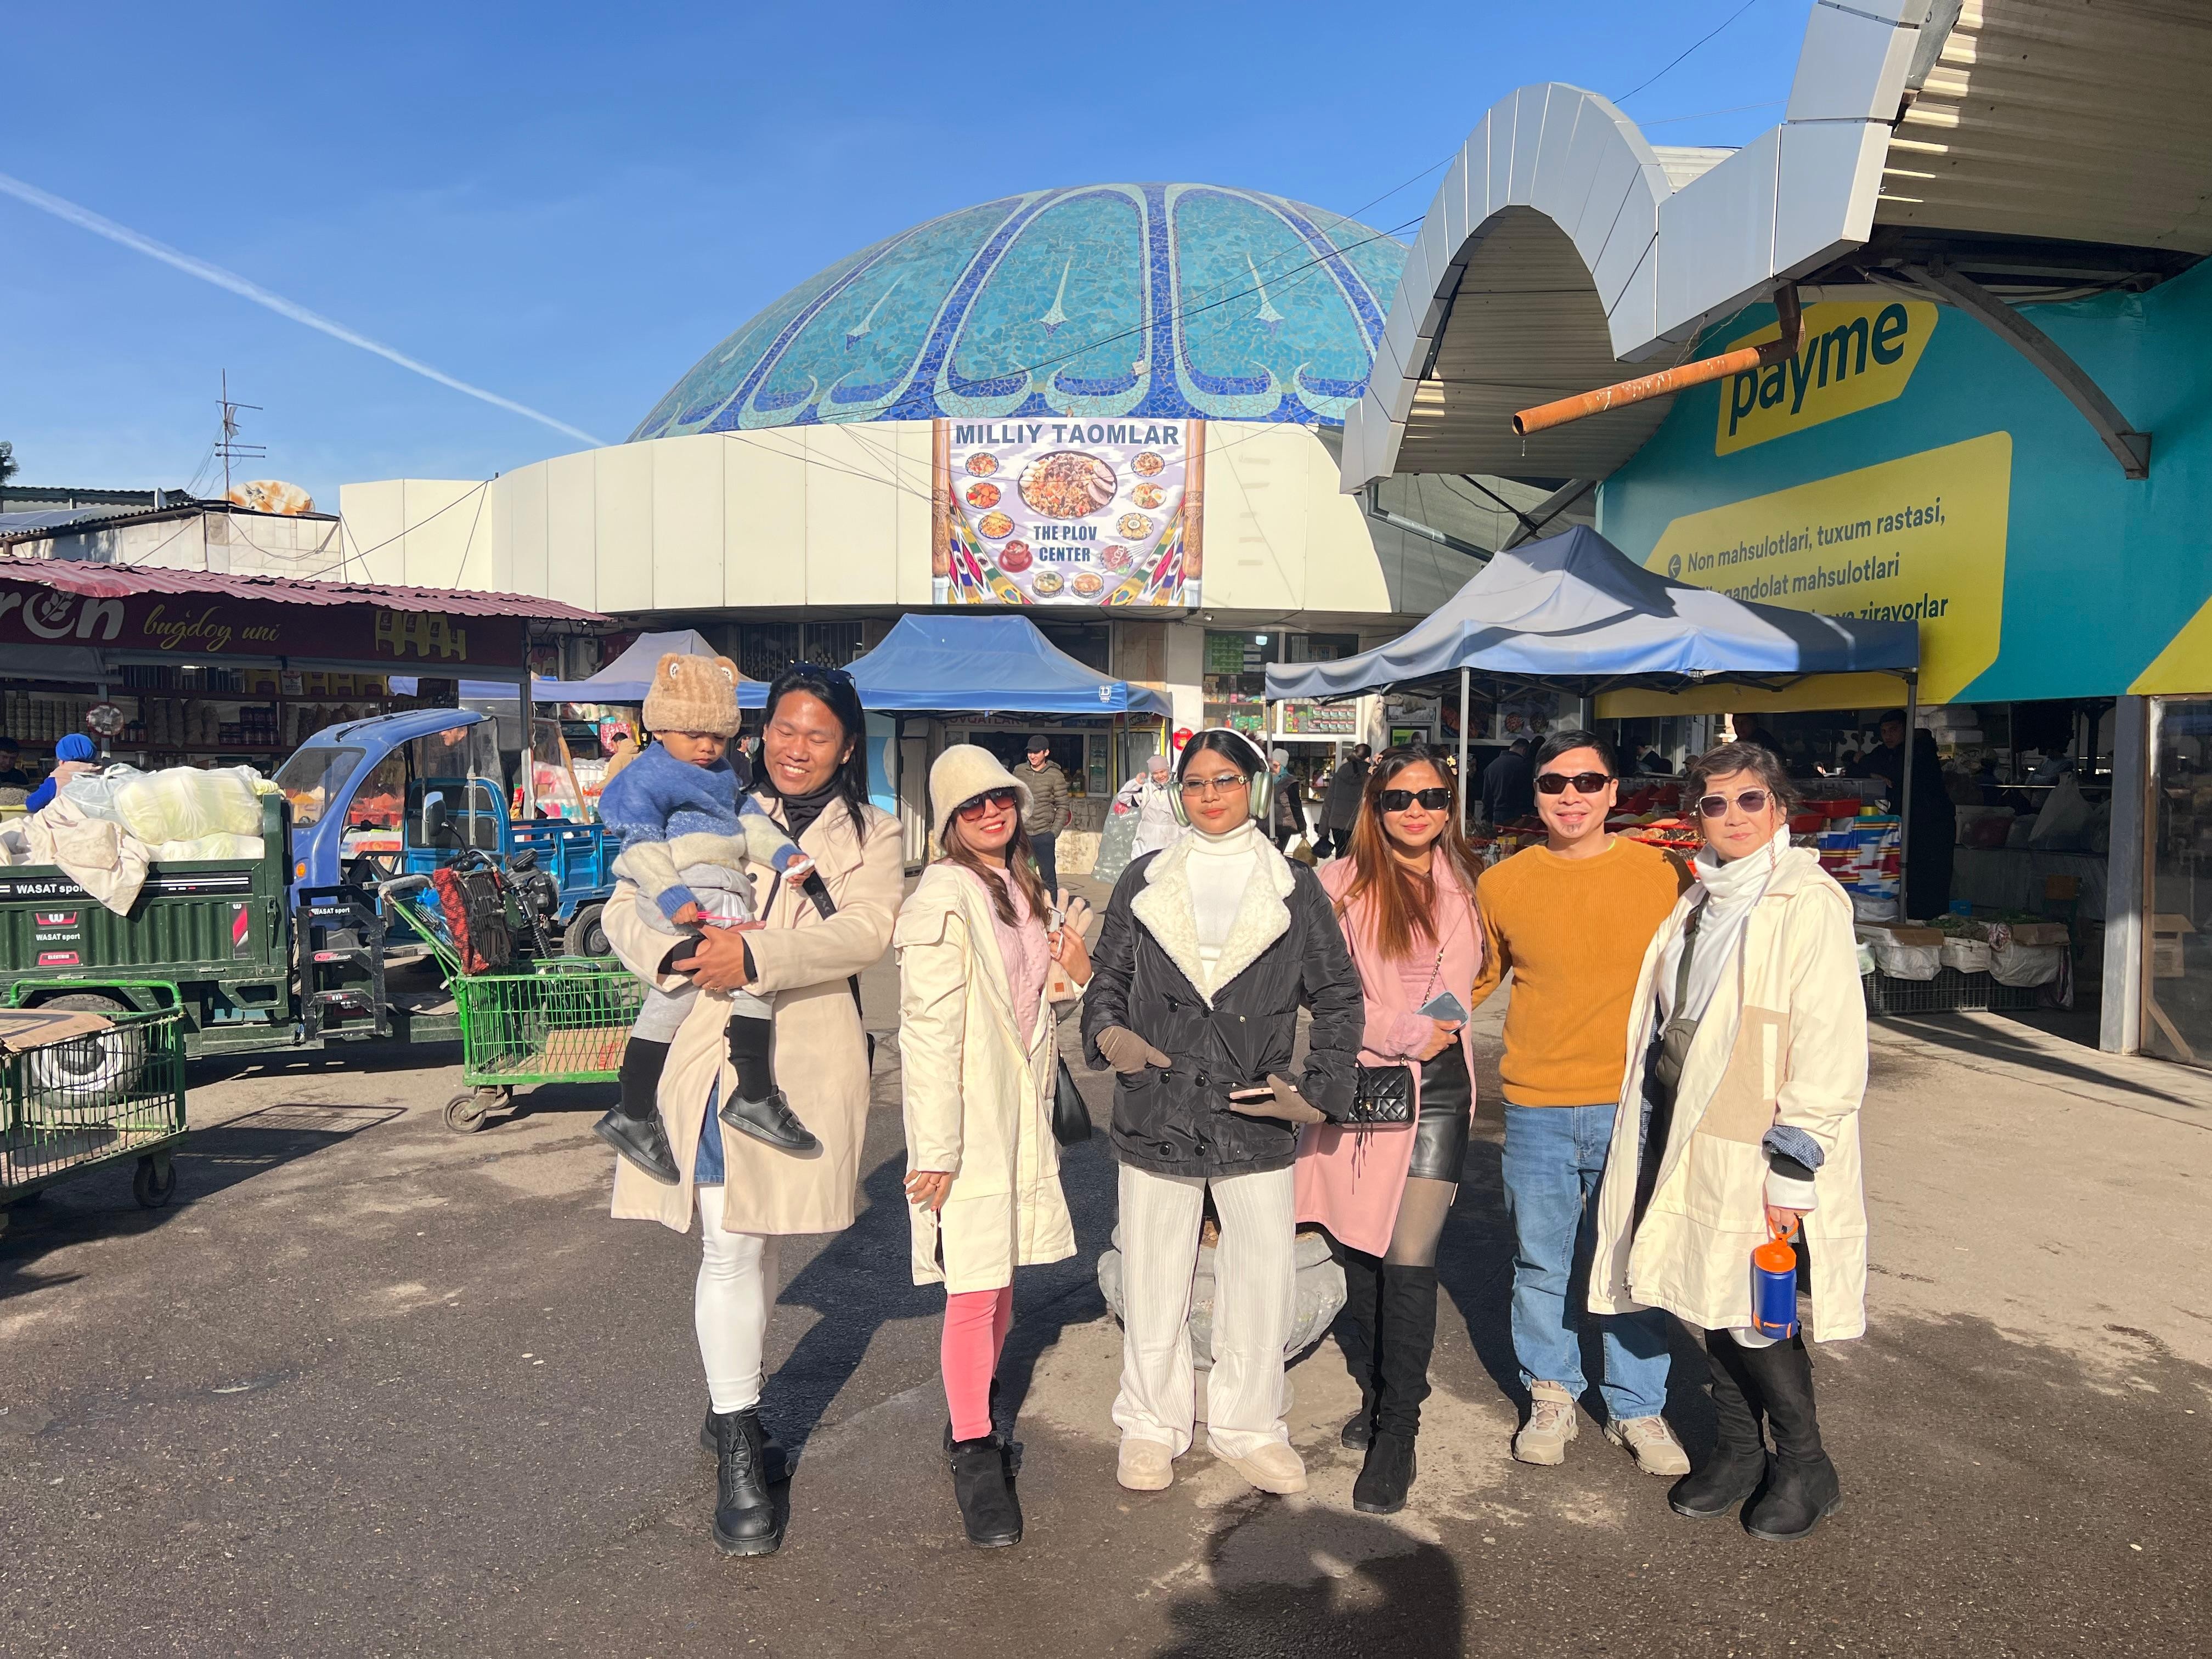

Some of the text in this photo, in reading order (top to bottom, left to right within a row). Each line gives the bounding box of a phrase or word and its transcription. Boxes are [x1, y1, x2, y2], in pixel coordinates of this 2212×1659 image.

[1729, 303, 1908, 437] payme
[956, 424, 1179, 445] MILLIY TAOMLAR
[1034, 526, 1097, 541] THE PLOV
[1688, 496, 1945, 573] Non mahsulotlari, tuxum rastasi,
[1039, 546, 1091, 562] CENTER
[1792, 551, 1900, 592] mahsulotlari
[242, 624, 281, 641] uni
[16, 884, 57, 894] WASAT
[61, 933, 81, 941] sport
